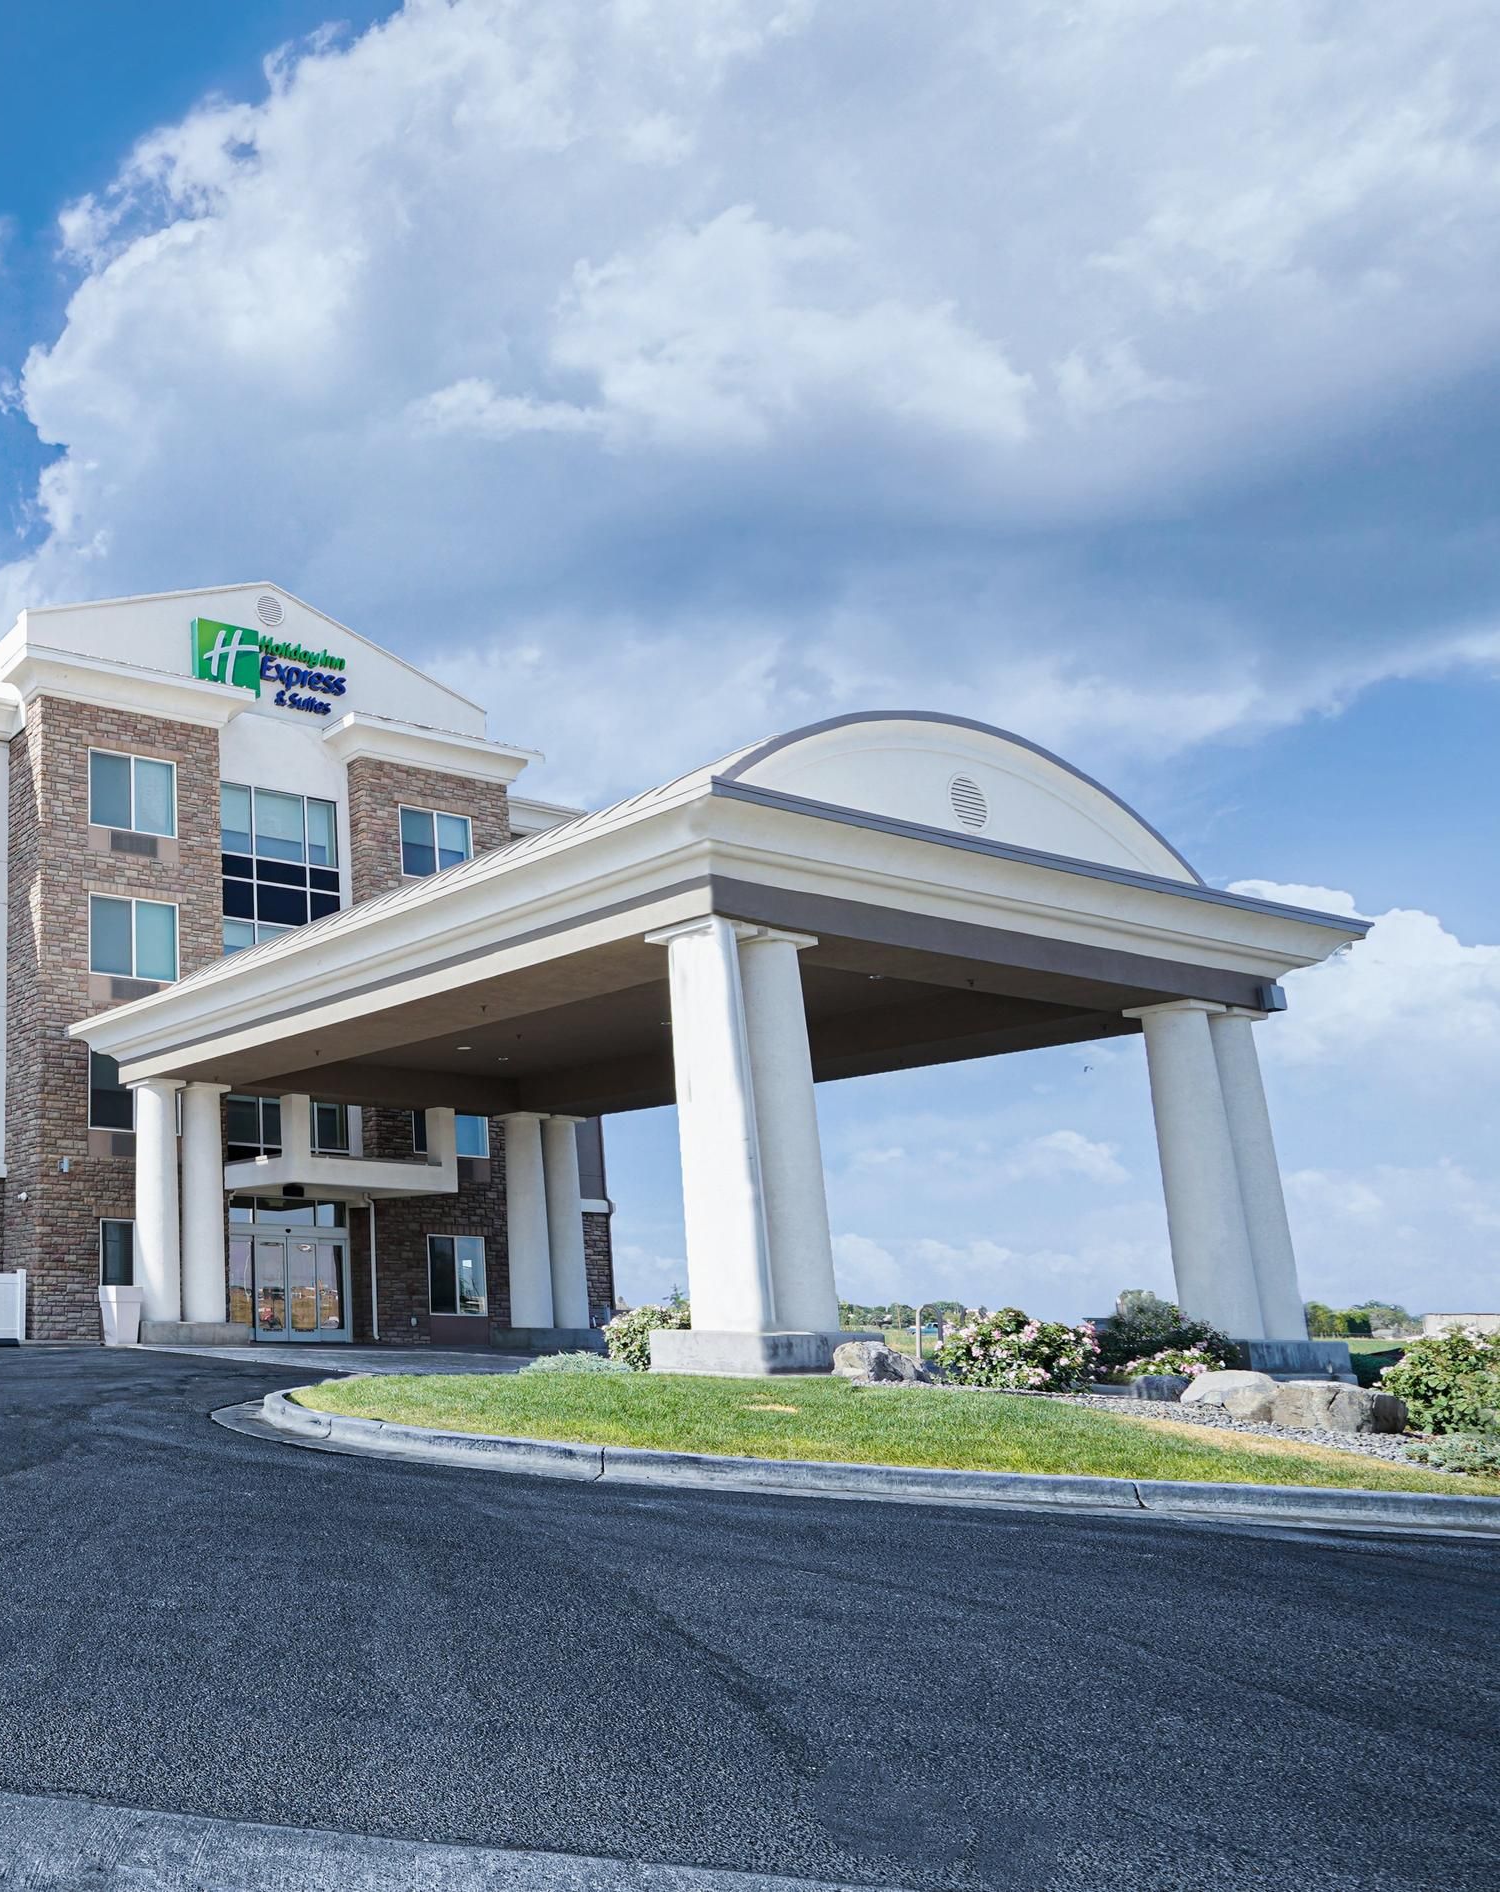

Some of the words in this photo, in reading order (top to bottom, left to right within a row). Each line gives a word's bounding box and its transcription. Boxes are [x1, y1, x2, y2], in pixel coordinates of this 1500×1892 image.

[259, 635, 320, 669] Holiday
[319, 648, 346, 671] Inn
[260, 655, 347, 696] Express
[274, 690, 287, 707] &
[288, 692, 332, 716] Suites
